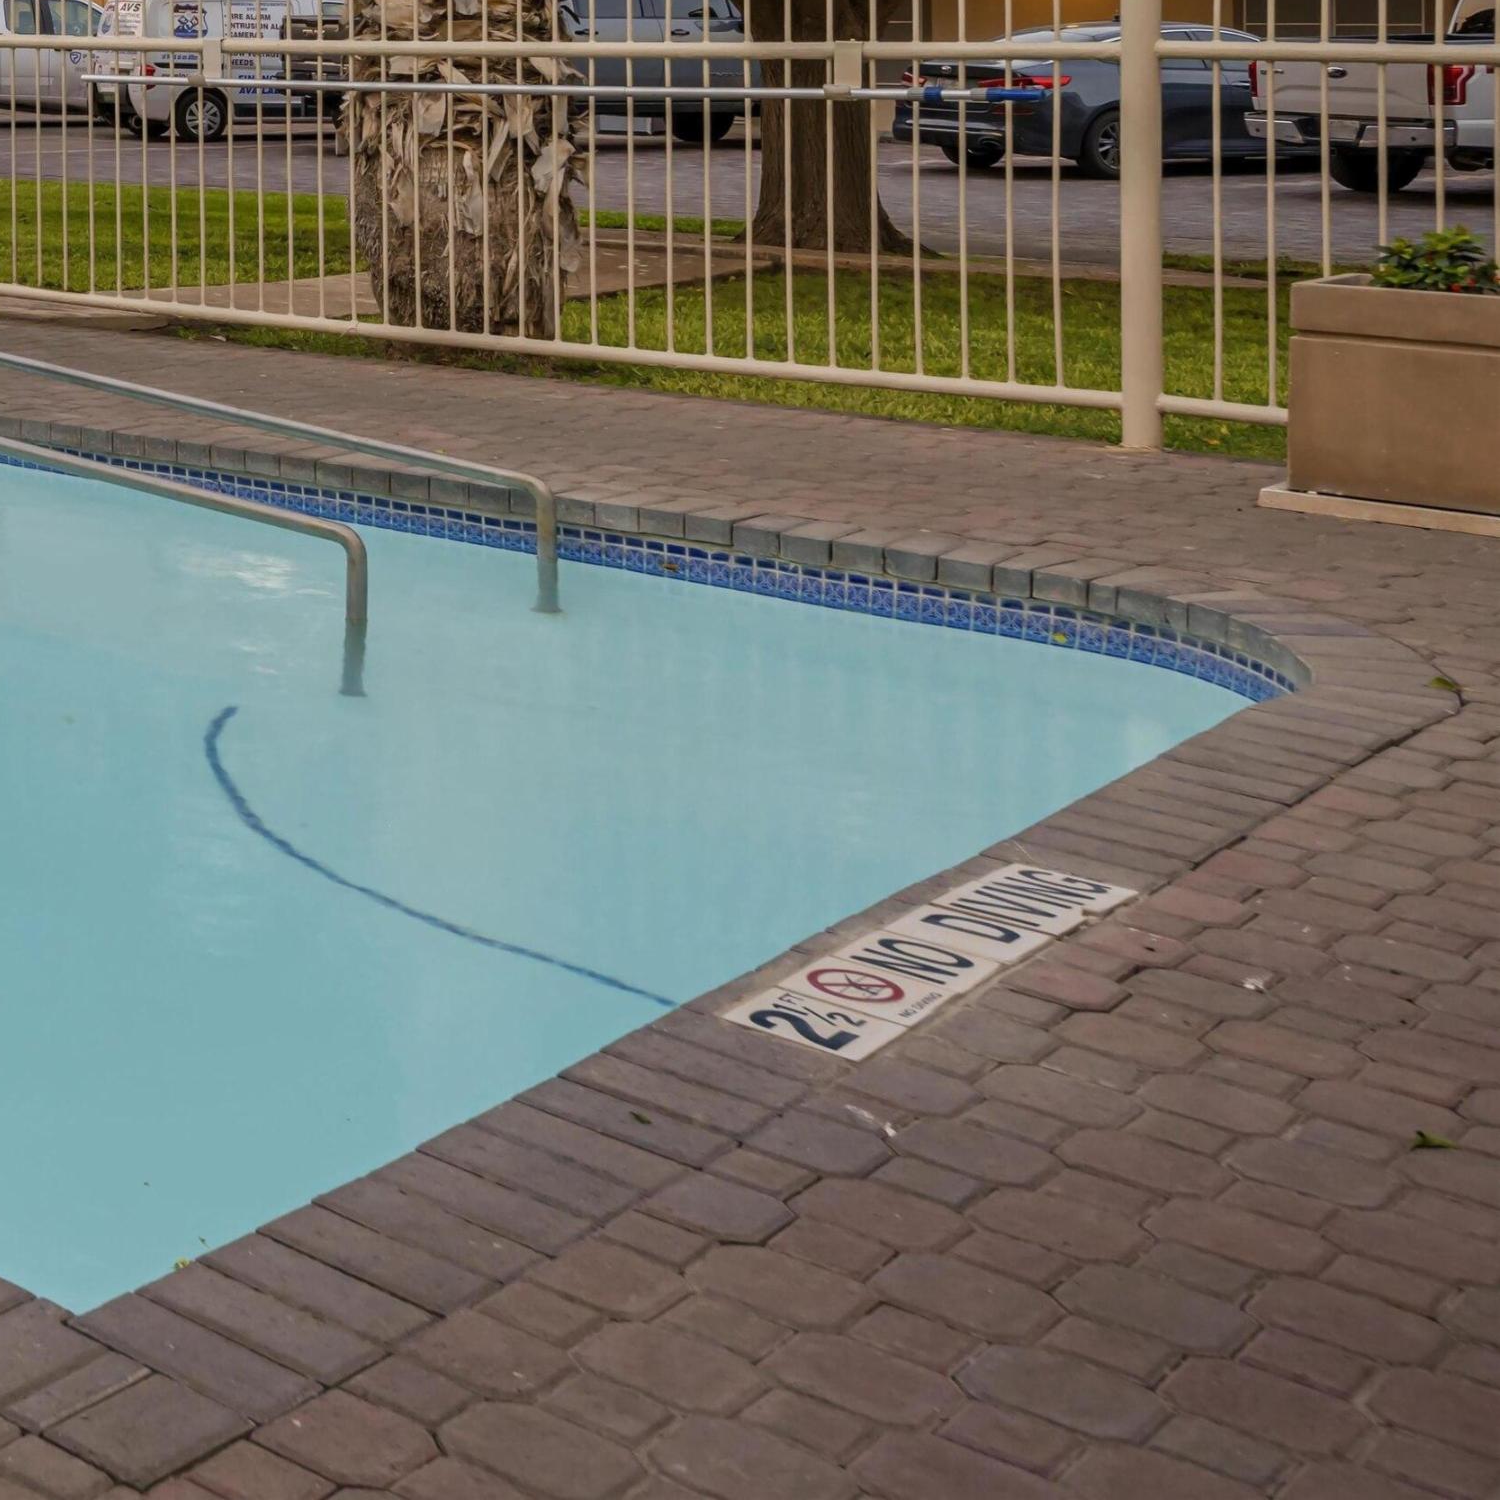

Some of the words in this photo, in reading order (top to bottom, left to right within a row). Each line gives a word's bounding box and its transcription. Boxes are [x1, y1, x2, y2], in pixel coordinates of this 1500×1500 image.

[119, 3, 142, 12] AVS
[849, 937, 975, 985] NO
[919, 868, 1113, 944] DIVING
[897, 1008, 916, 1019] NO
[914, 991, 943, 1012] DIVING
